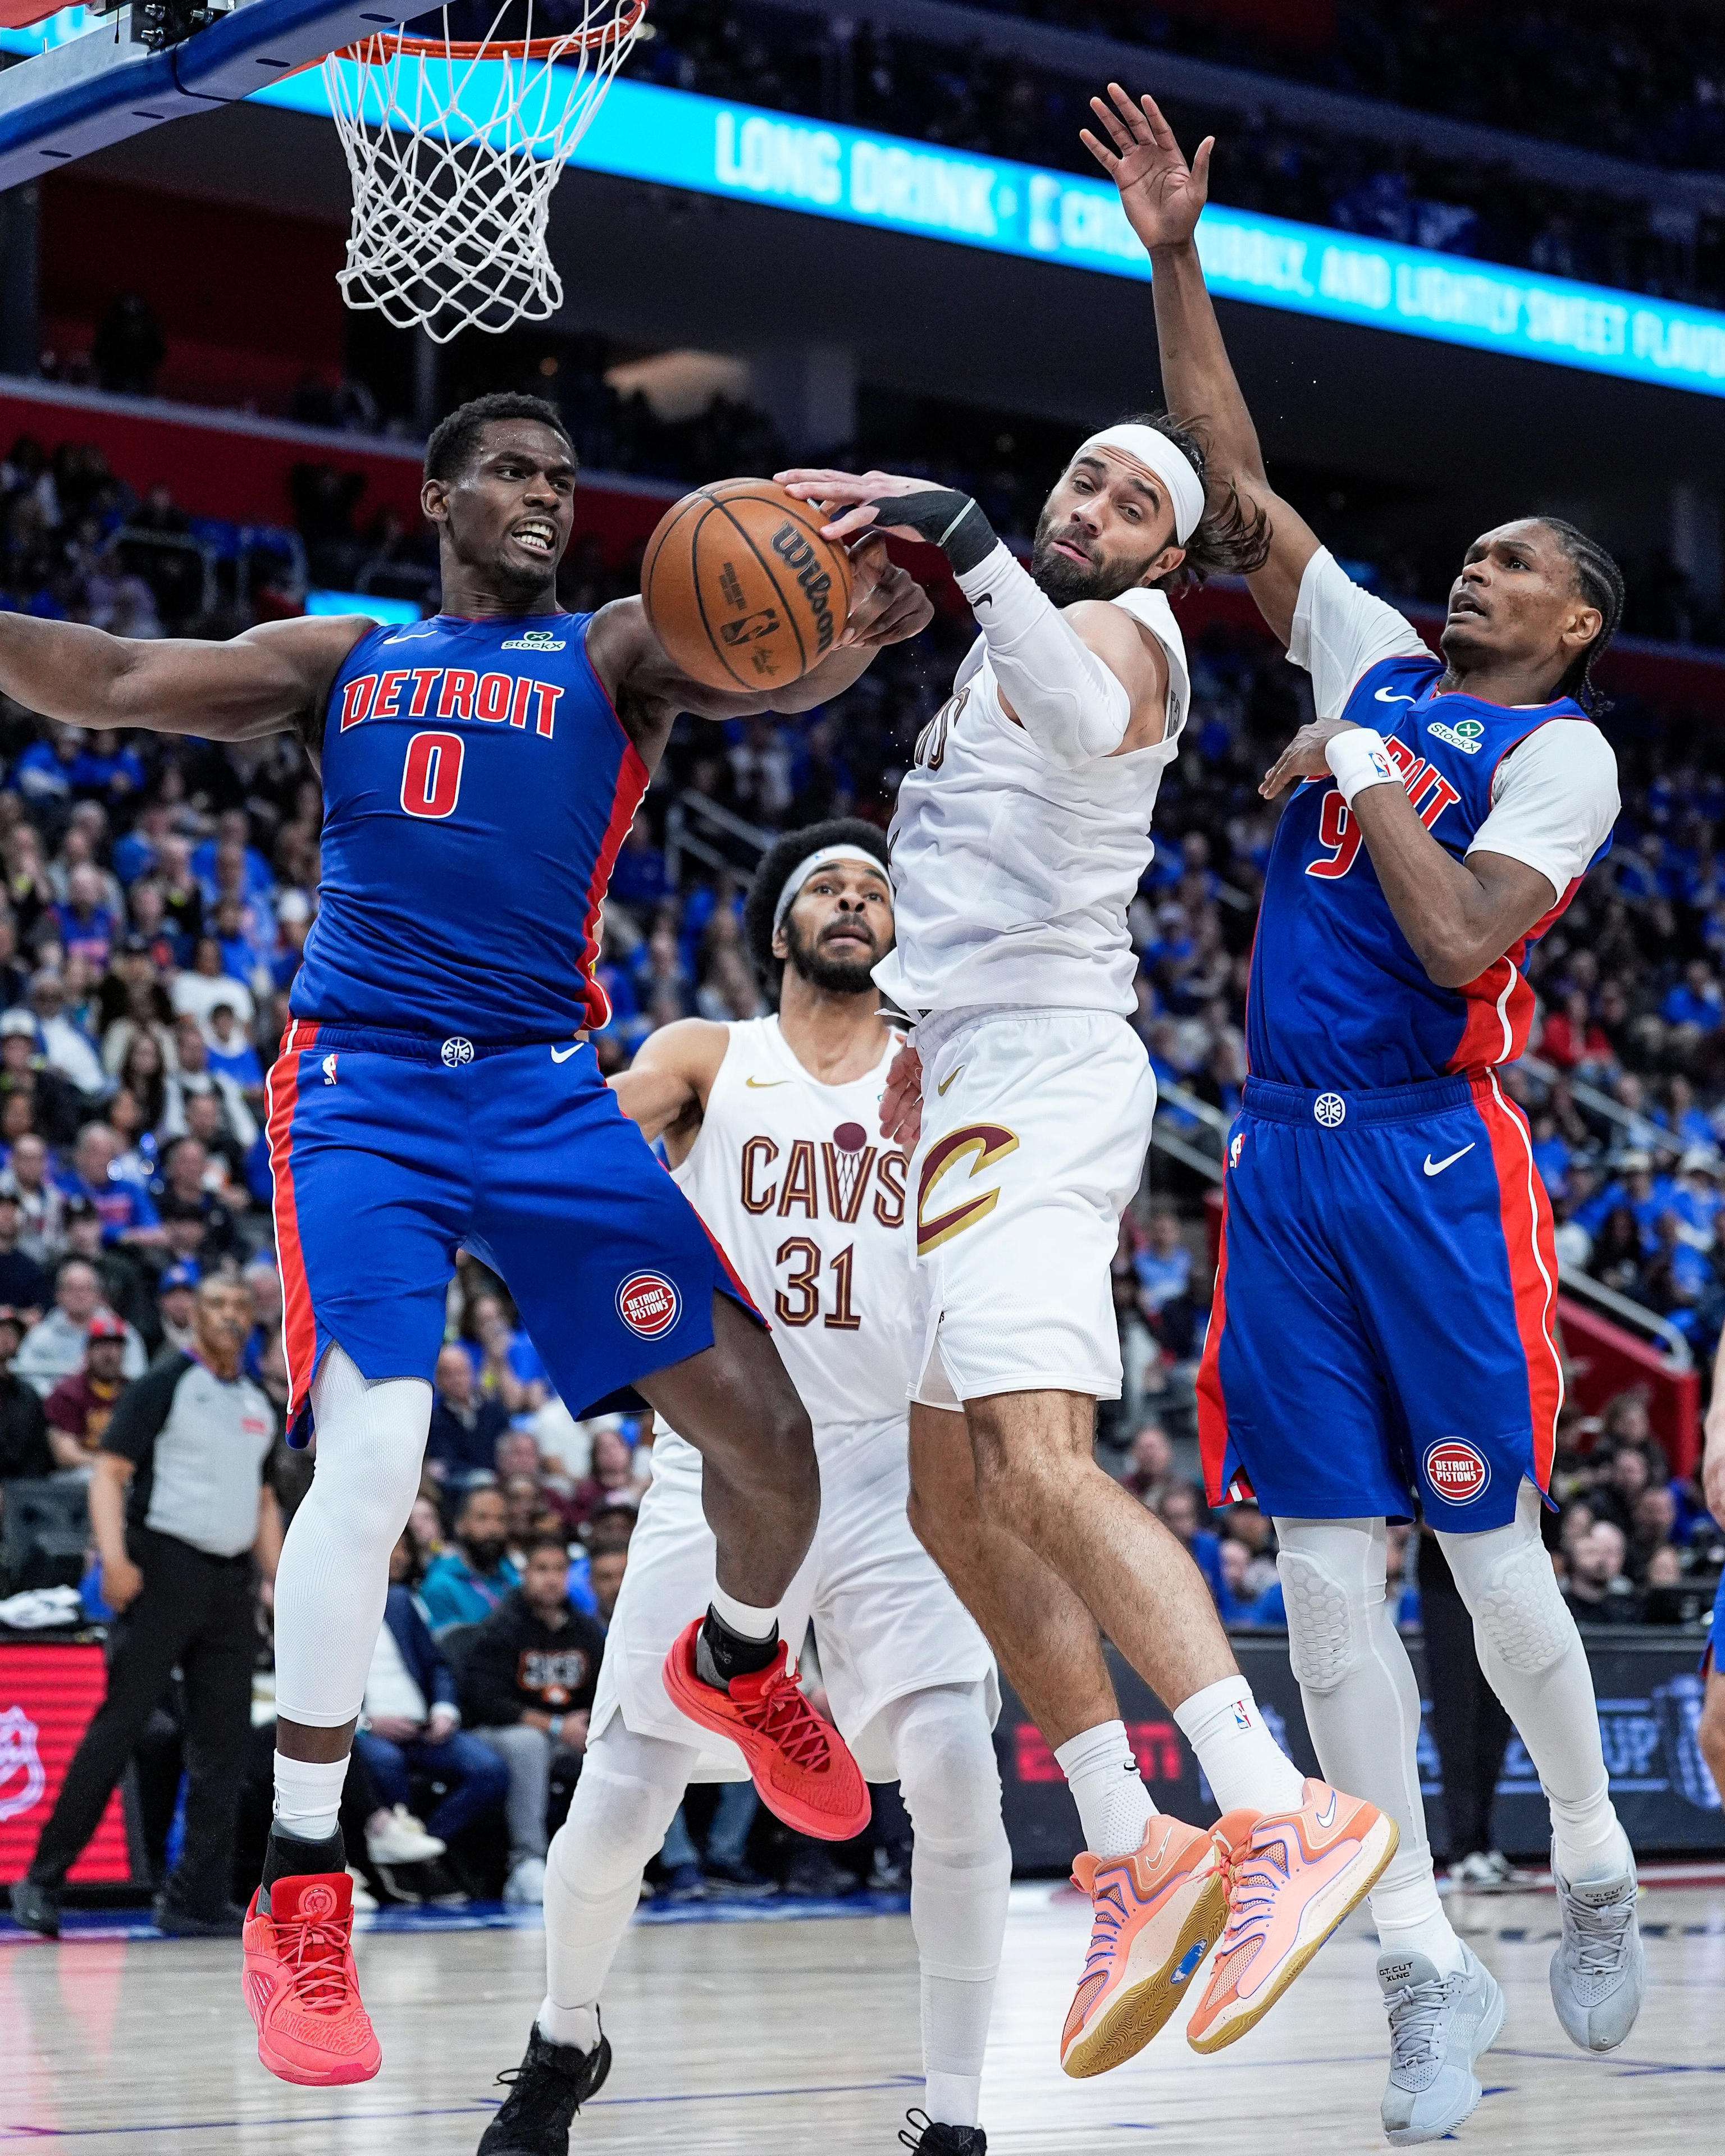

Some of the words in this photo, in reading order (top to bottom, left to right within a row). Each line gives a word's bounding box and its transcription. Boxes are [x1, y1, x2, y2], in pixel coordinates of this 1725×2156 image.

[715, 111, 841, 204] LONG
[850, 140, 998, 238] DRINK
[1320, 245, 1391, 310] AND
[340, 668, 565, 739] DETROIT
[400, 731, 466, 819] 0
[1305, 789, 1363, 880] 9
[740, 1135, 910, 1230] CAVS
[626, 1288, 665, 1312] DETROIT
[629, 1298, 669, 1322] PISTONS
[774, 1236, 861, 1331] 31
[1434, 1460, 1475, 1472] DETROIT
[1435, 1470, 1477, 1482] PISTONS
[1392, 1962, 1414, 1973] CUT
